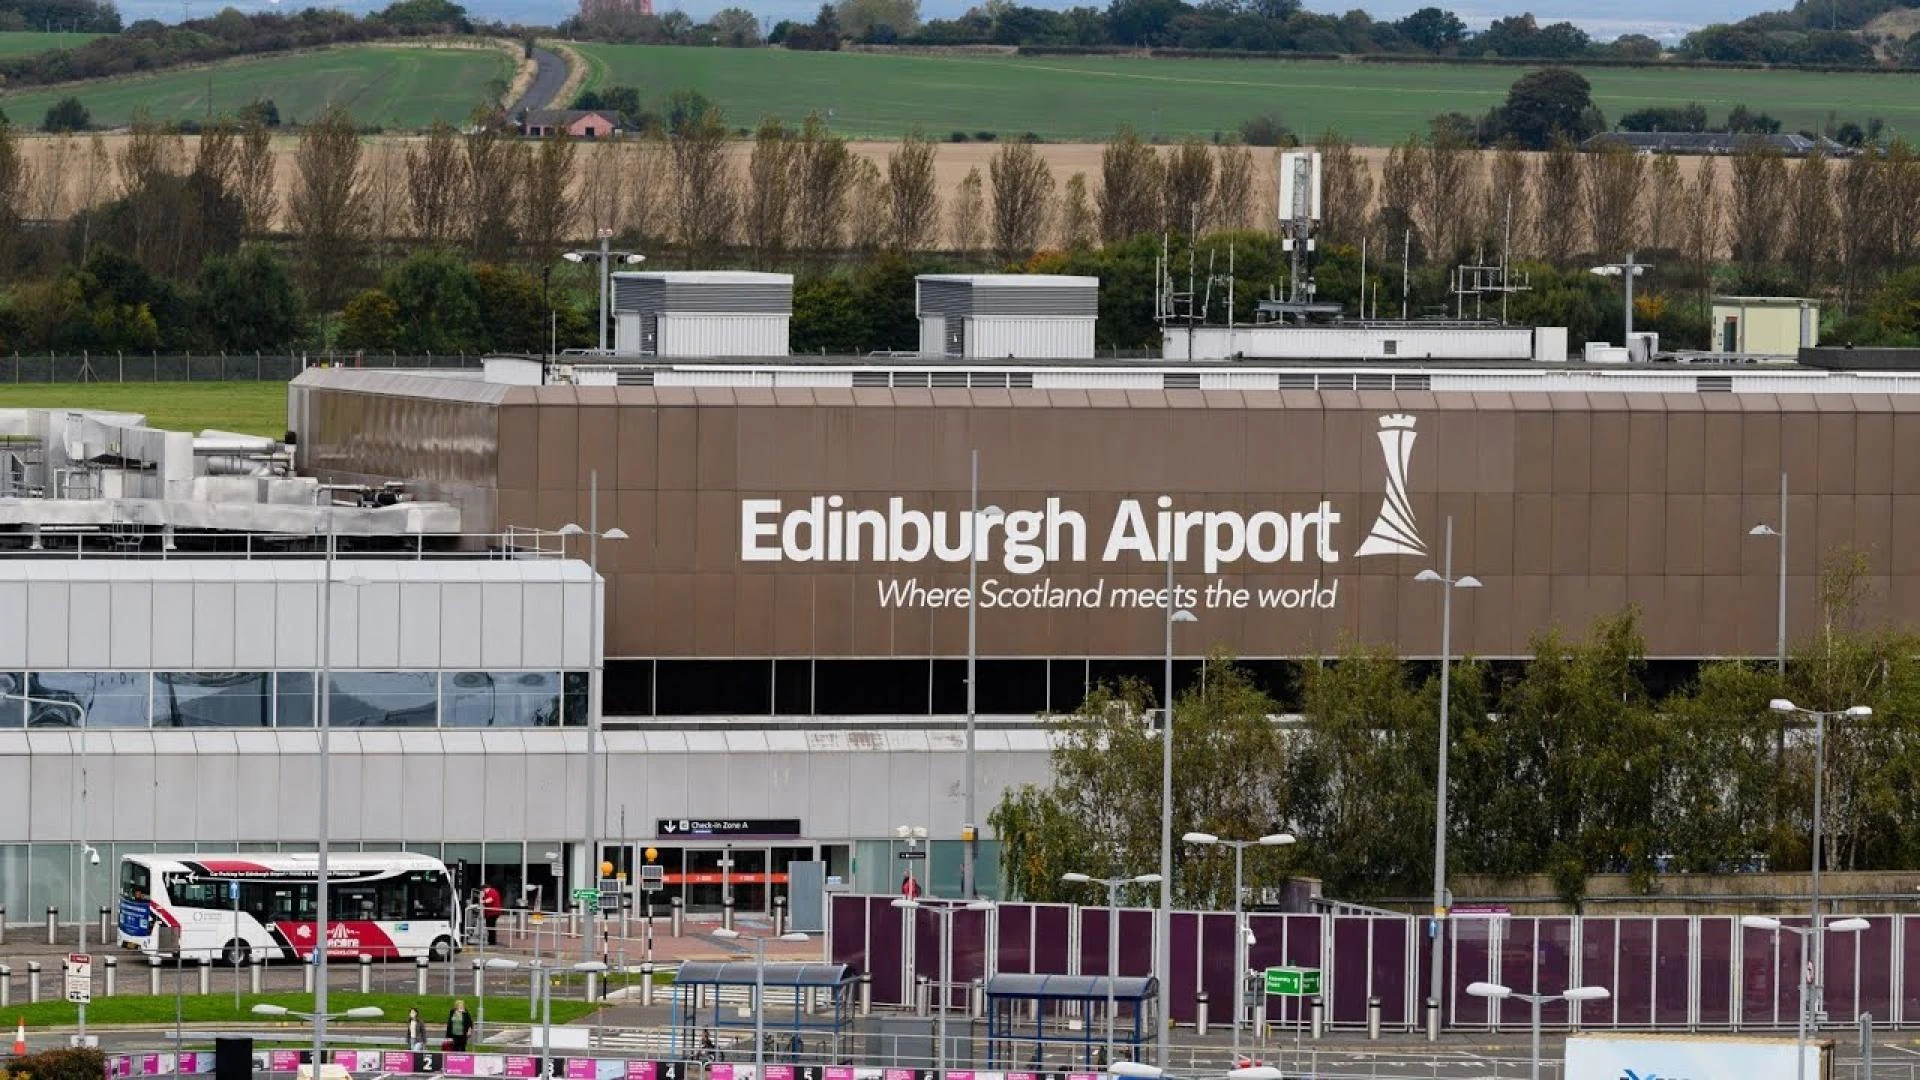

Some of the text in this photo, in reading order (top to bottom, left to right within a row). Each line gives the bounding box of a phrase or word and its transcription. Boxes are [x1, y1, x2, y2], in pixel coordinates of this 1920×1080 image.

[742, 495, 1340, 574] Edinburgh Airport
[878, 578, 1338, 608] Where Scotland meets the world
[691, 821, 749, 829] Check-in Zone A
[422, 1057, 433, 1071] 2
[665, 1067, 676, 1080] 4
